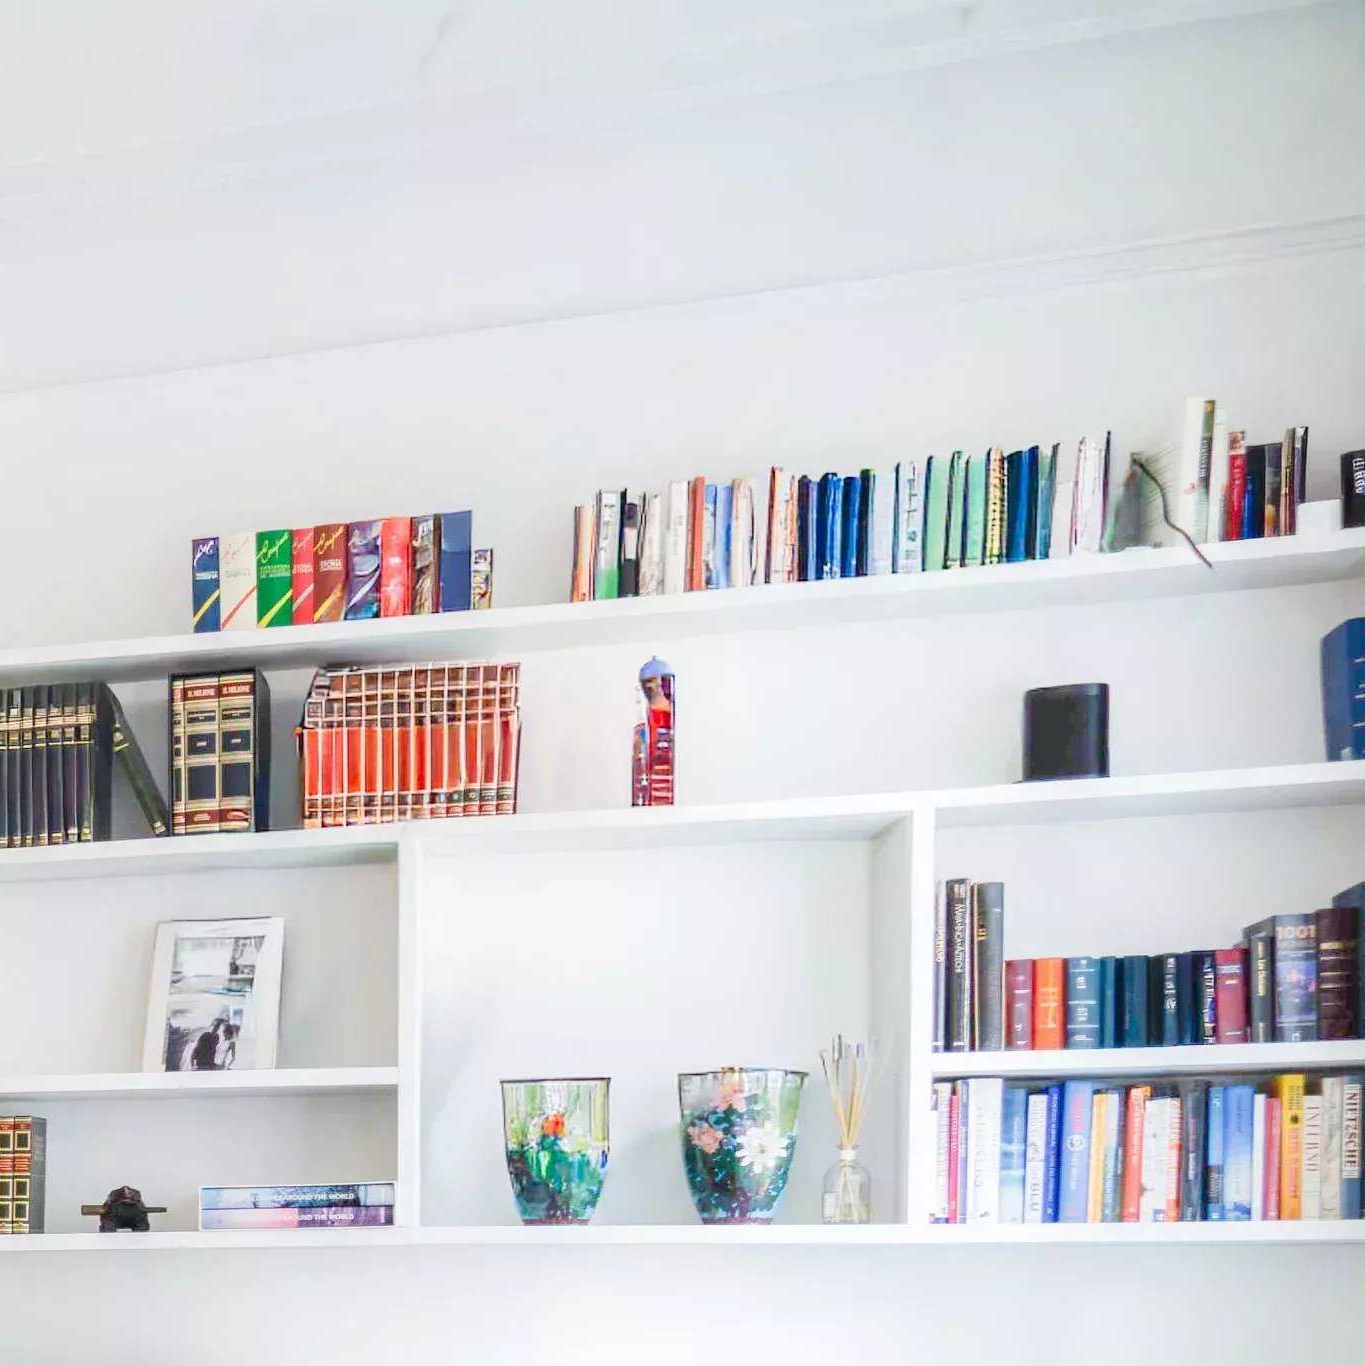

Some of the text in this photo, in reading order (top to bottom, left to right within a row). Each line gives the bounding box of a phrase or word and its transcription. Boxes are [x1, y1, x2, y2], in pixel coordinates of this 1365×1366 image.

[1275, 926, 1316, 940] 1001
[1343, 1092, 1358, 1169] NIETZSCHE
[314, 1192, 327, 1200] THE
[329, 1191, 354, 1200] WORLD
[314, 1213, 327, 1221] THE
[329, 1213, 354, 1221] WORLD
